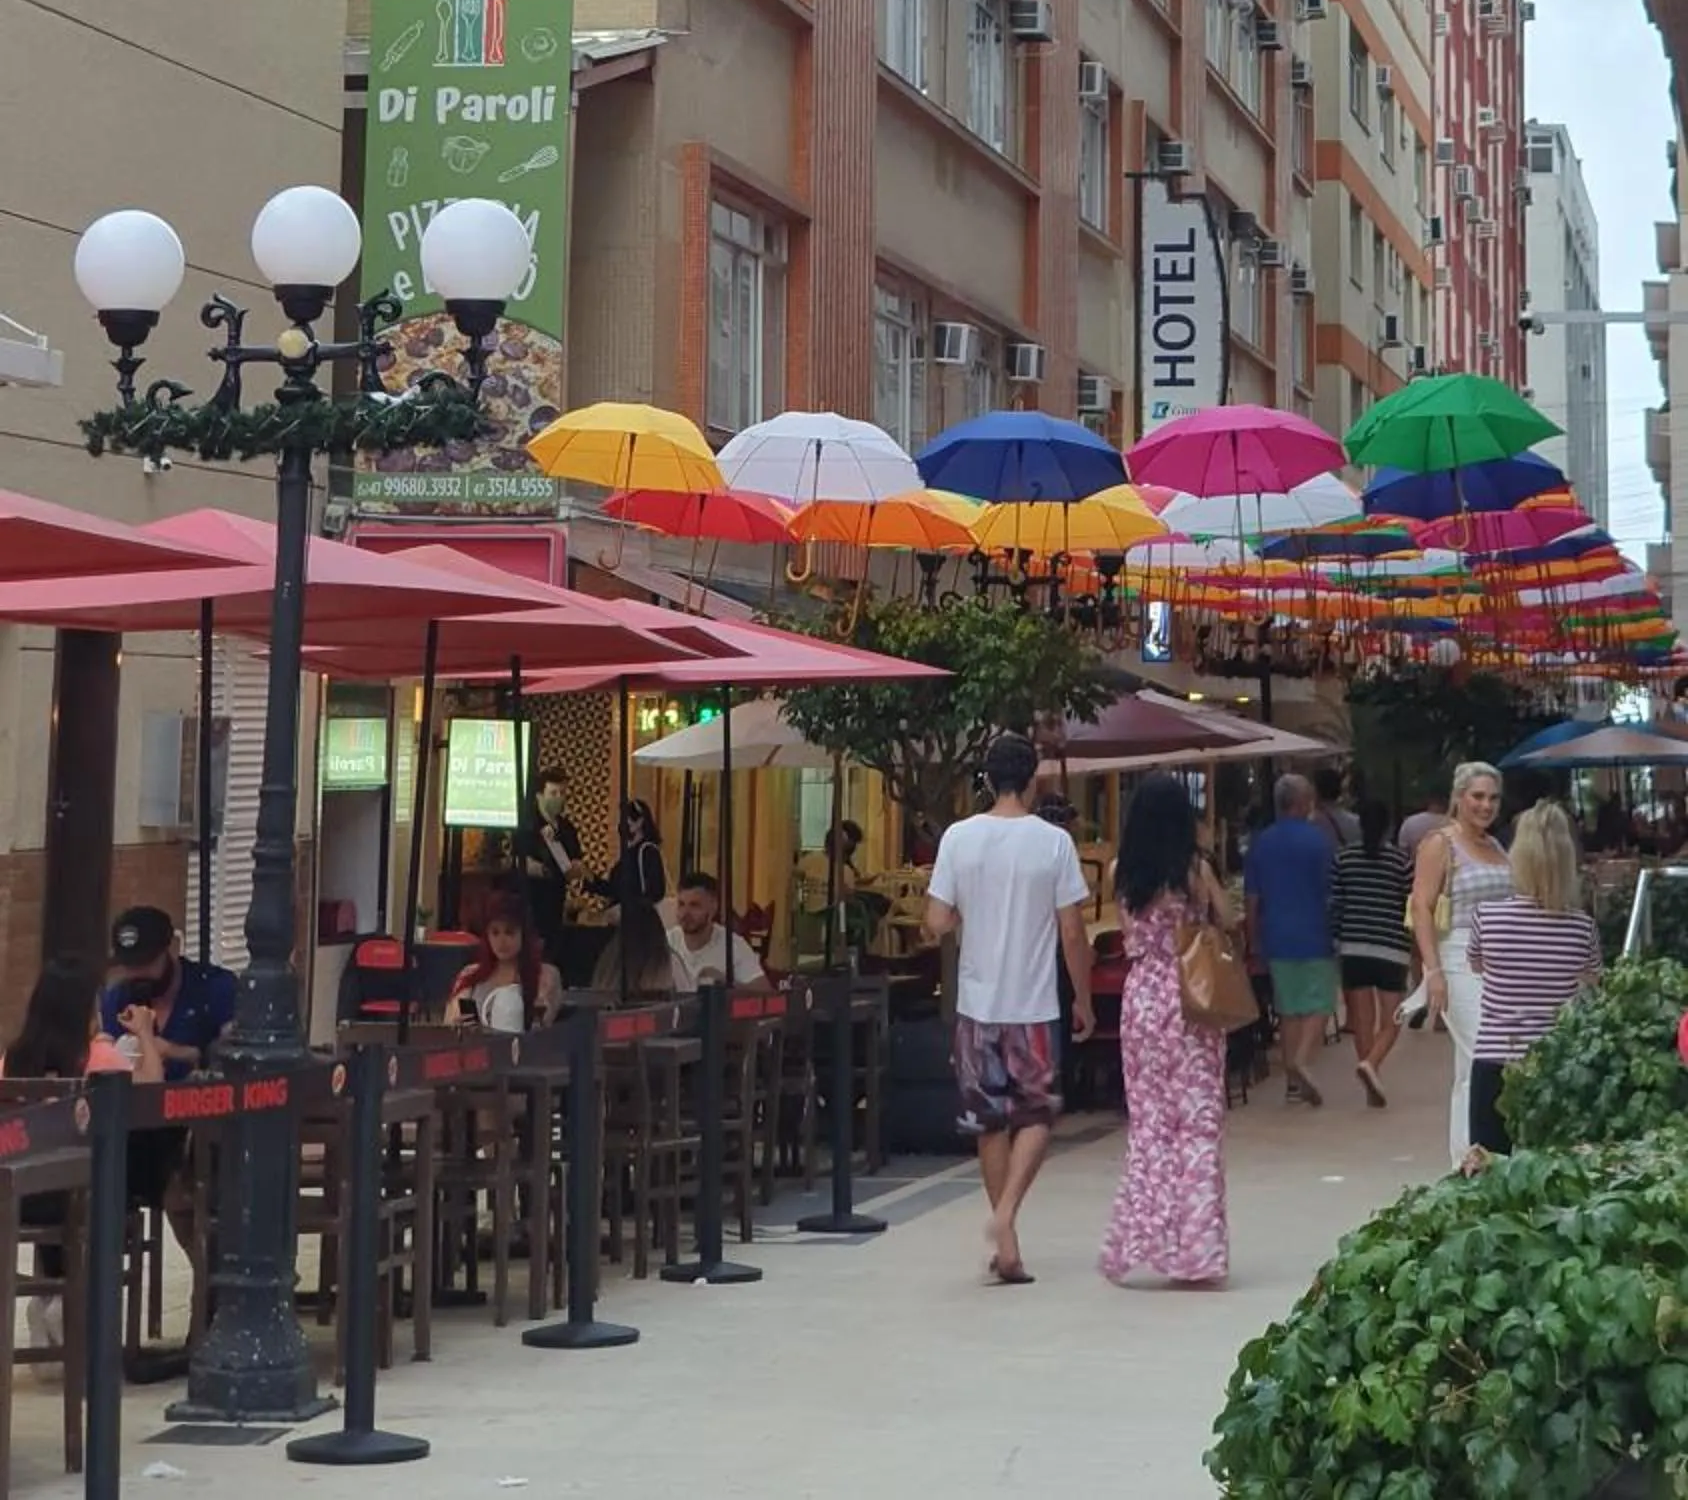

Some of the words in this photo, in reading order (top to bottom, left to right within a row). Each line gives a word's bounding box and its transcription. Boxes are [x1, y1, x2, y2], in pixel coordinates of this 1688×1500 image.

[379, 86, 418, 123] Di
[436, 85, 557, 125] Paroli
[1153, 227, 1196, 388] HOTEL
[474, 757, 514, 775] Paro
[164, 1084, 235, 1119] BURGER
[243, 1078, 288, 1109] KING
